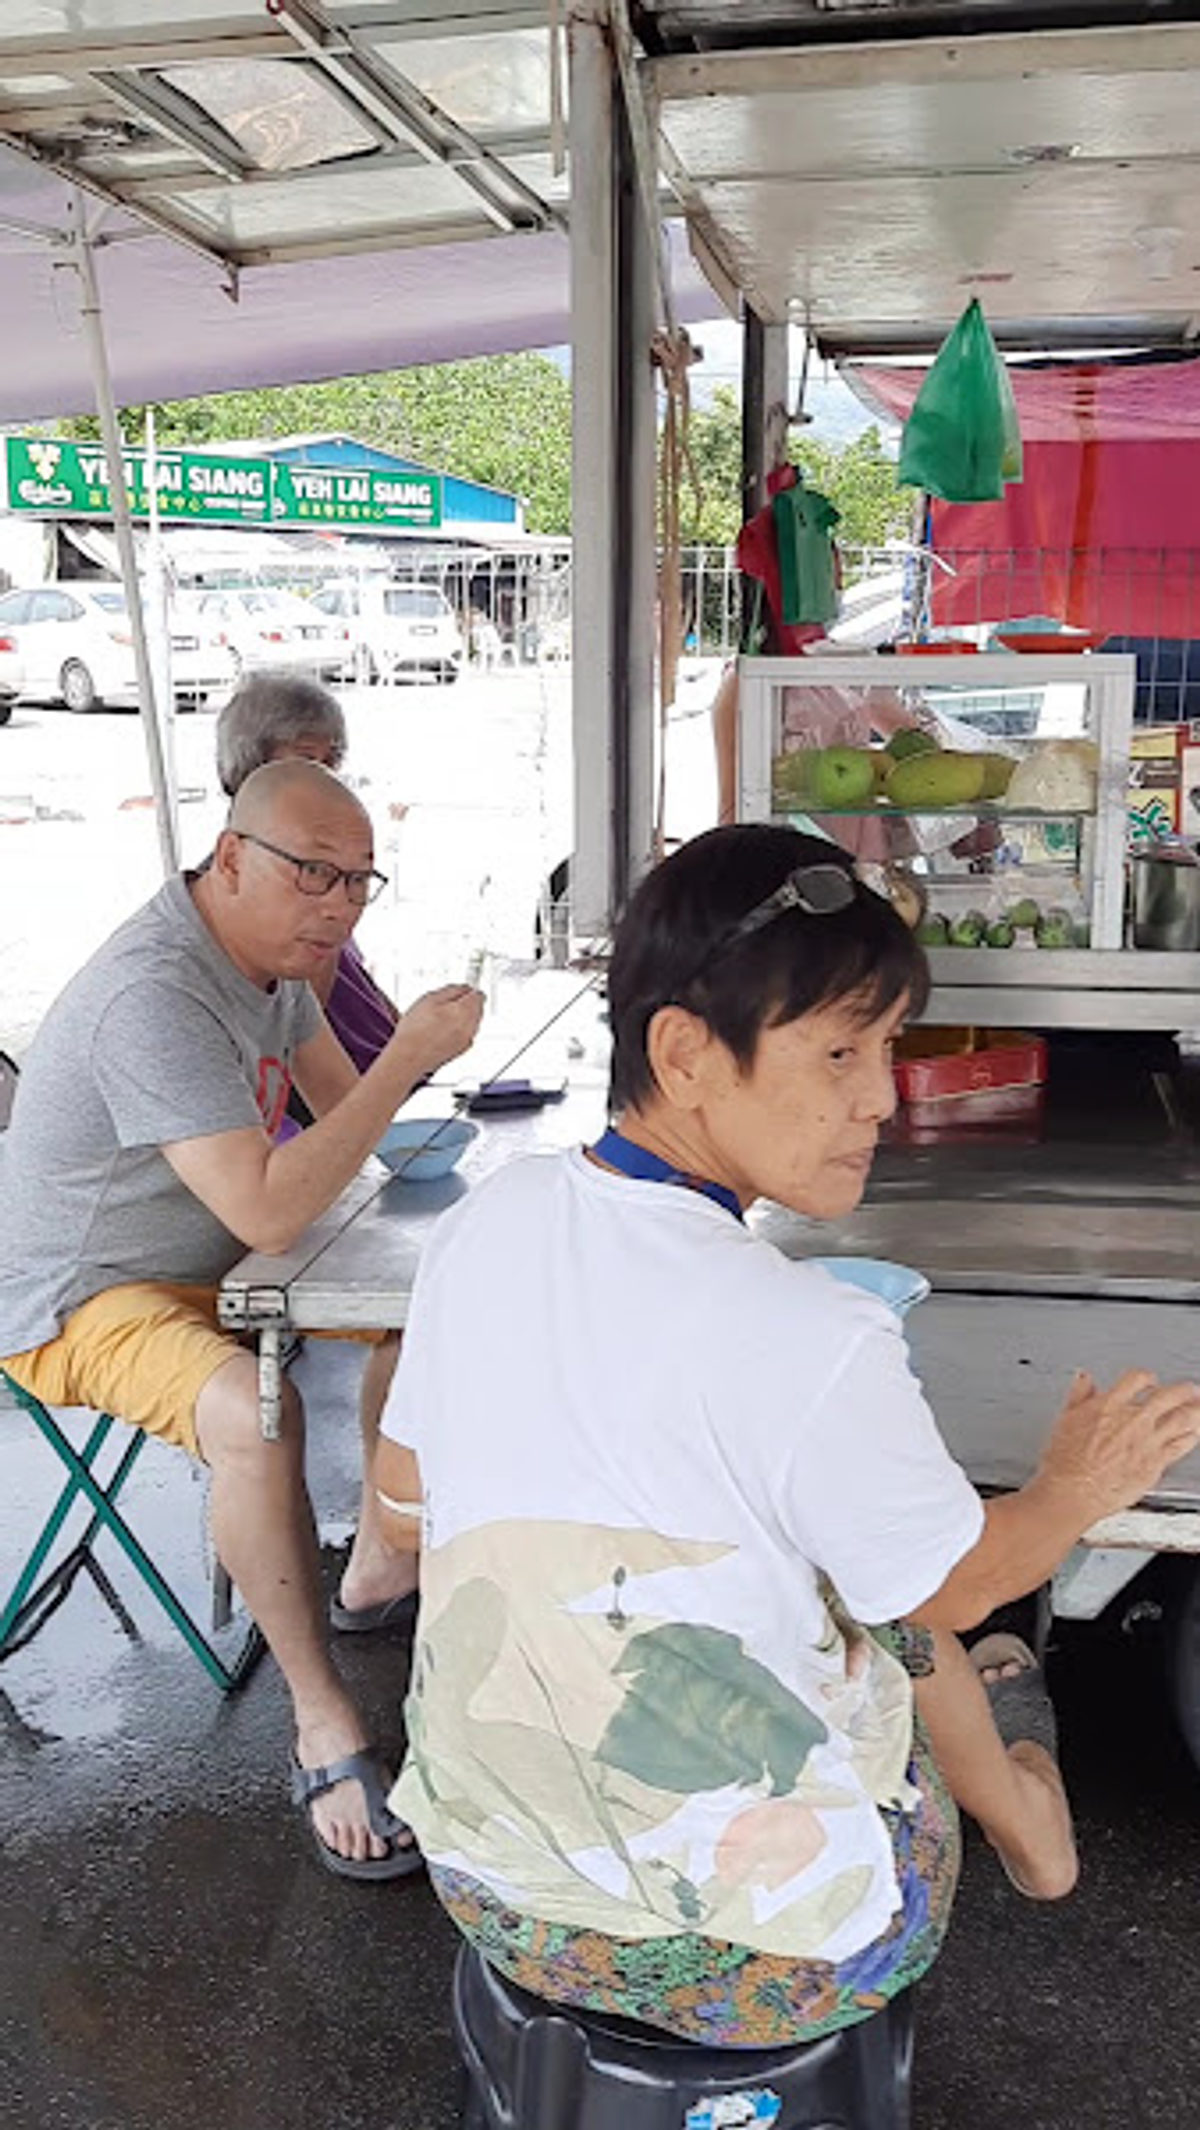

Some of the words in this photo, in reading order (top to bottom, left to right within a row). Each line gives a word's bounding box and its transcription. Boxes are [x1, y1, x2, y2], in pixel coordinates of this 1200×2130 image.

[188, 466, 263, 497] SIANG
[290, 475, 332, 499] YEH
[337, 478, 369, 502] LAI
[373, 481, 431, 506] SIANG
